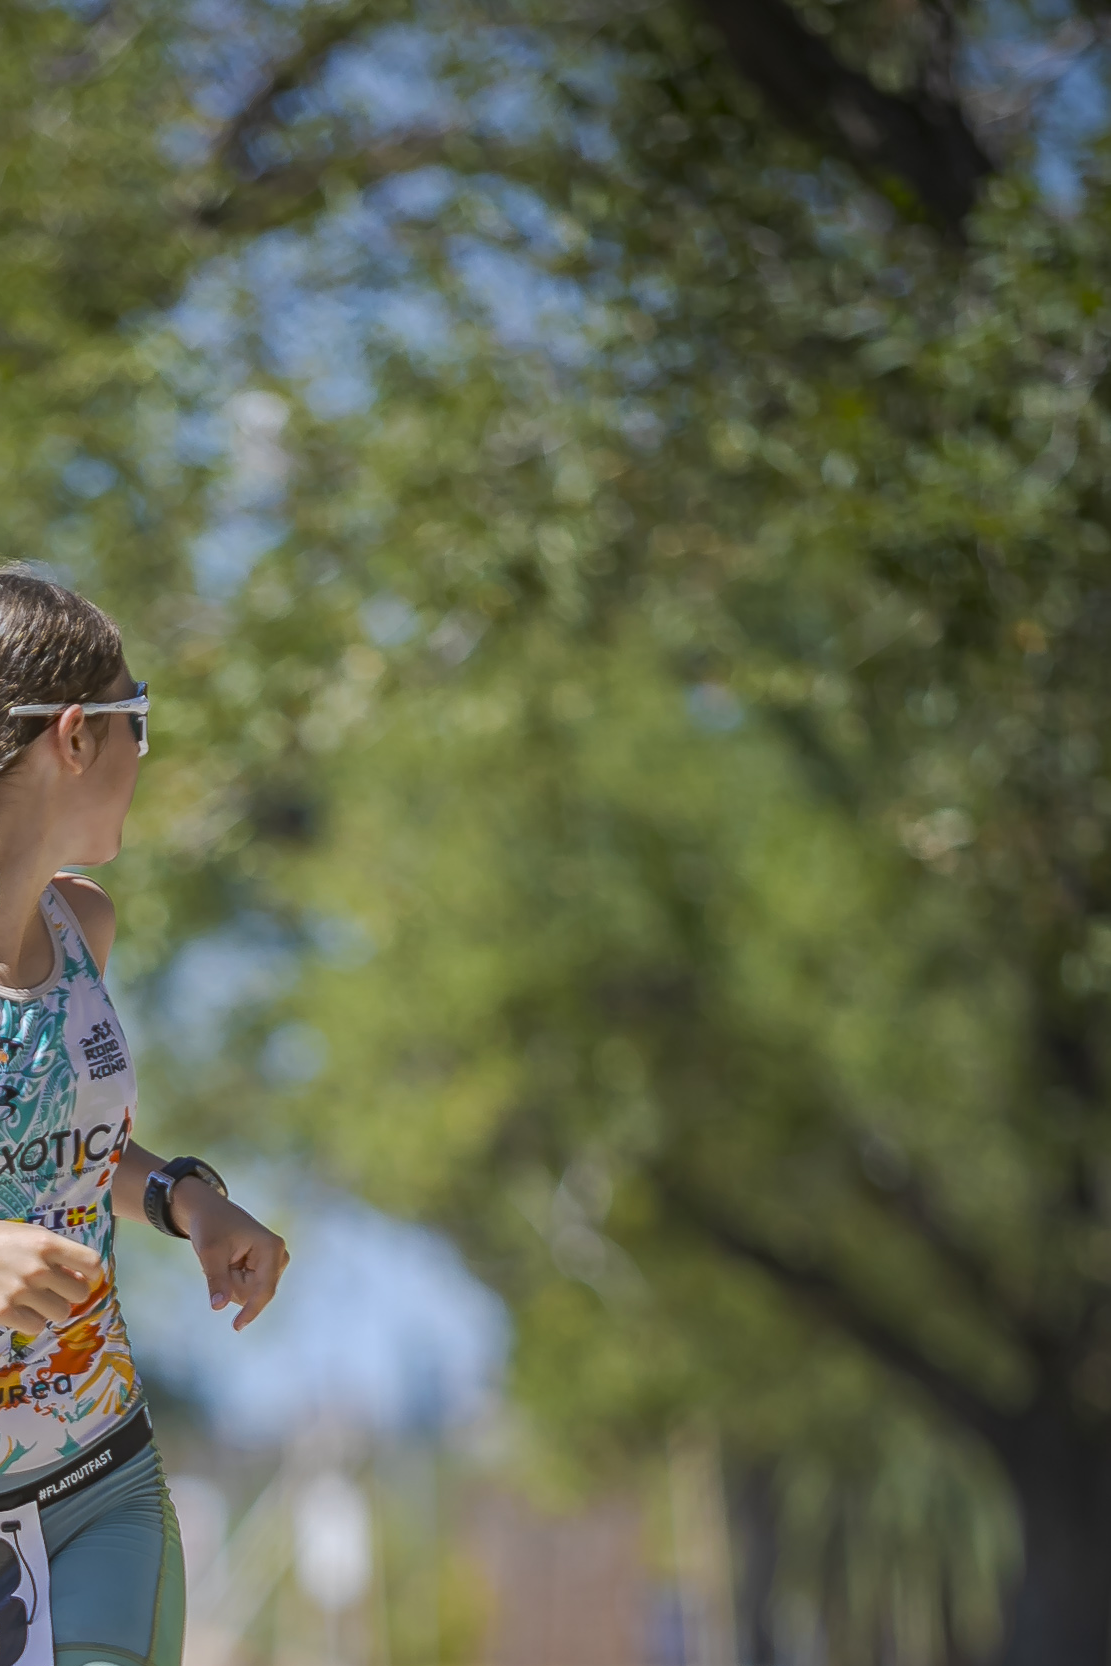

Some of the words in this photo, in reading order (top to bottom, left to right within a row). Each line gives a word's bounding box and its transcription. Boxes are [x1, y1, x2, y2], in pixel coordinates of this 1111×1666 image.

[84, 1038, 119, 1060] ROAD
[89, 1057, 127, 1080] KONA
[37, 1448, 113, 1500] #FLATOUTFAST
